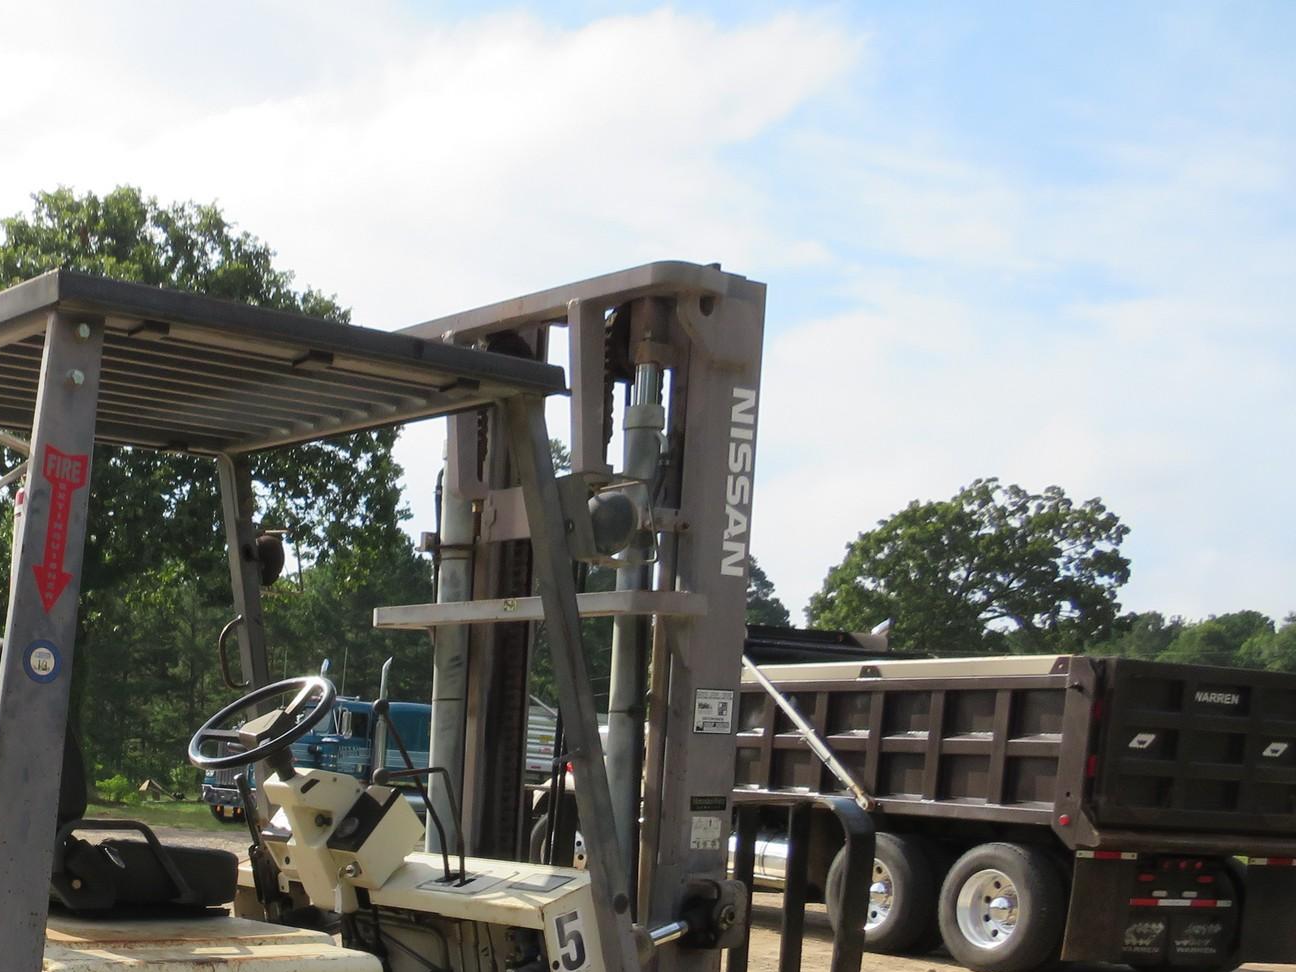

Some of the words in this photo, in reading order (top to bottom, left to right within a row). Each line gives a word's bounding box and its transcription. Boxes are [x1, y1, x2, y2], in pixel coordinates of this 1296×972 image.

[47, 454, 82, 483] FIRE
[720, 387, 757, 577] NISSAN
[1194, 691, 1240, 705] WARREN
[555, 910, 586, 971] 5
